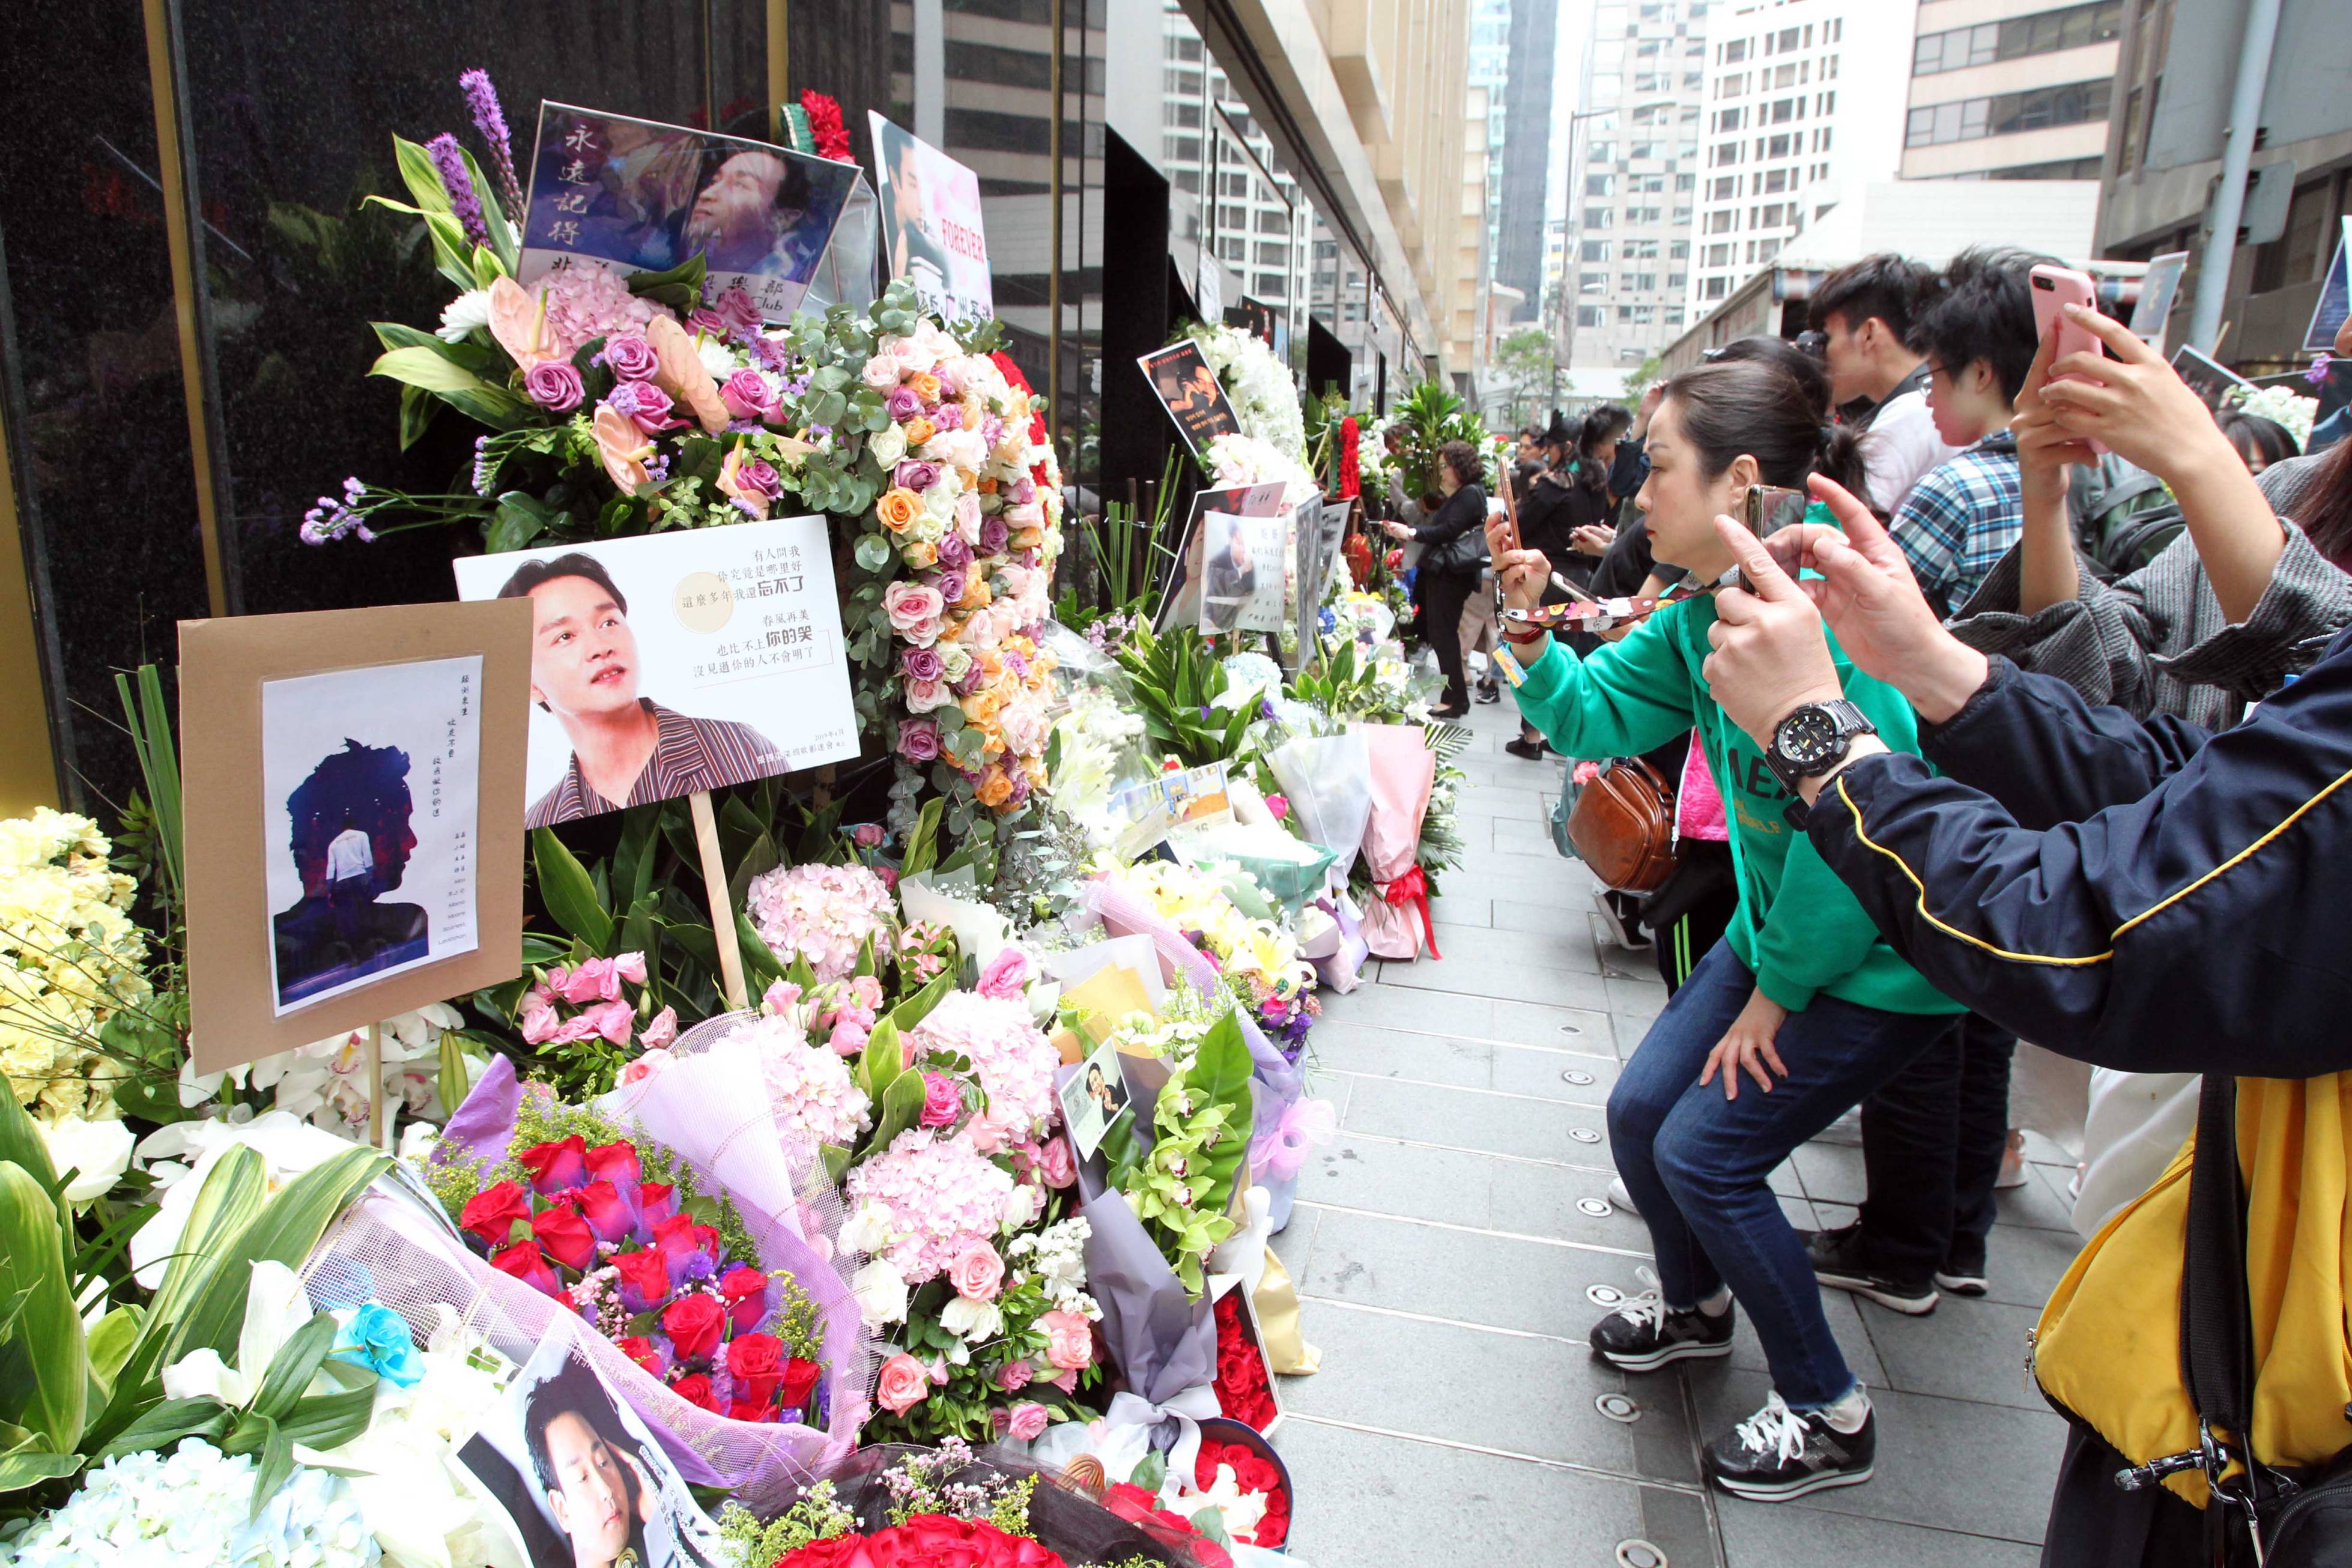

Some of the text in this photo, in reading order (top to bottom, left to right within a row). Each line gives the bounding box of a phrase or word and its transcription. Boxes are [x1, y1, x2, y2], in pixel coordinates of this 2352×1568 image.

[547, 124, 598, 246] 永遠記得
[941, 217, 984, 264] FOREVER
[751, 296, 783, 311] Club
[753, 545, 801, 563] 有人問我
[717, 561, 802, 583] 你究竟是哪里好
[716, 626, 813, 656] 也比不上你的笑
